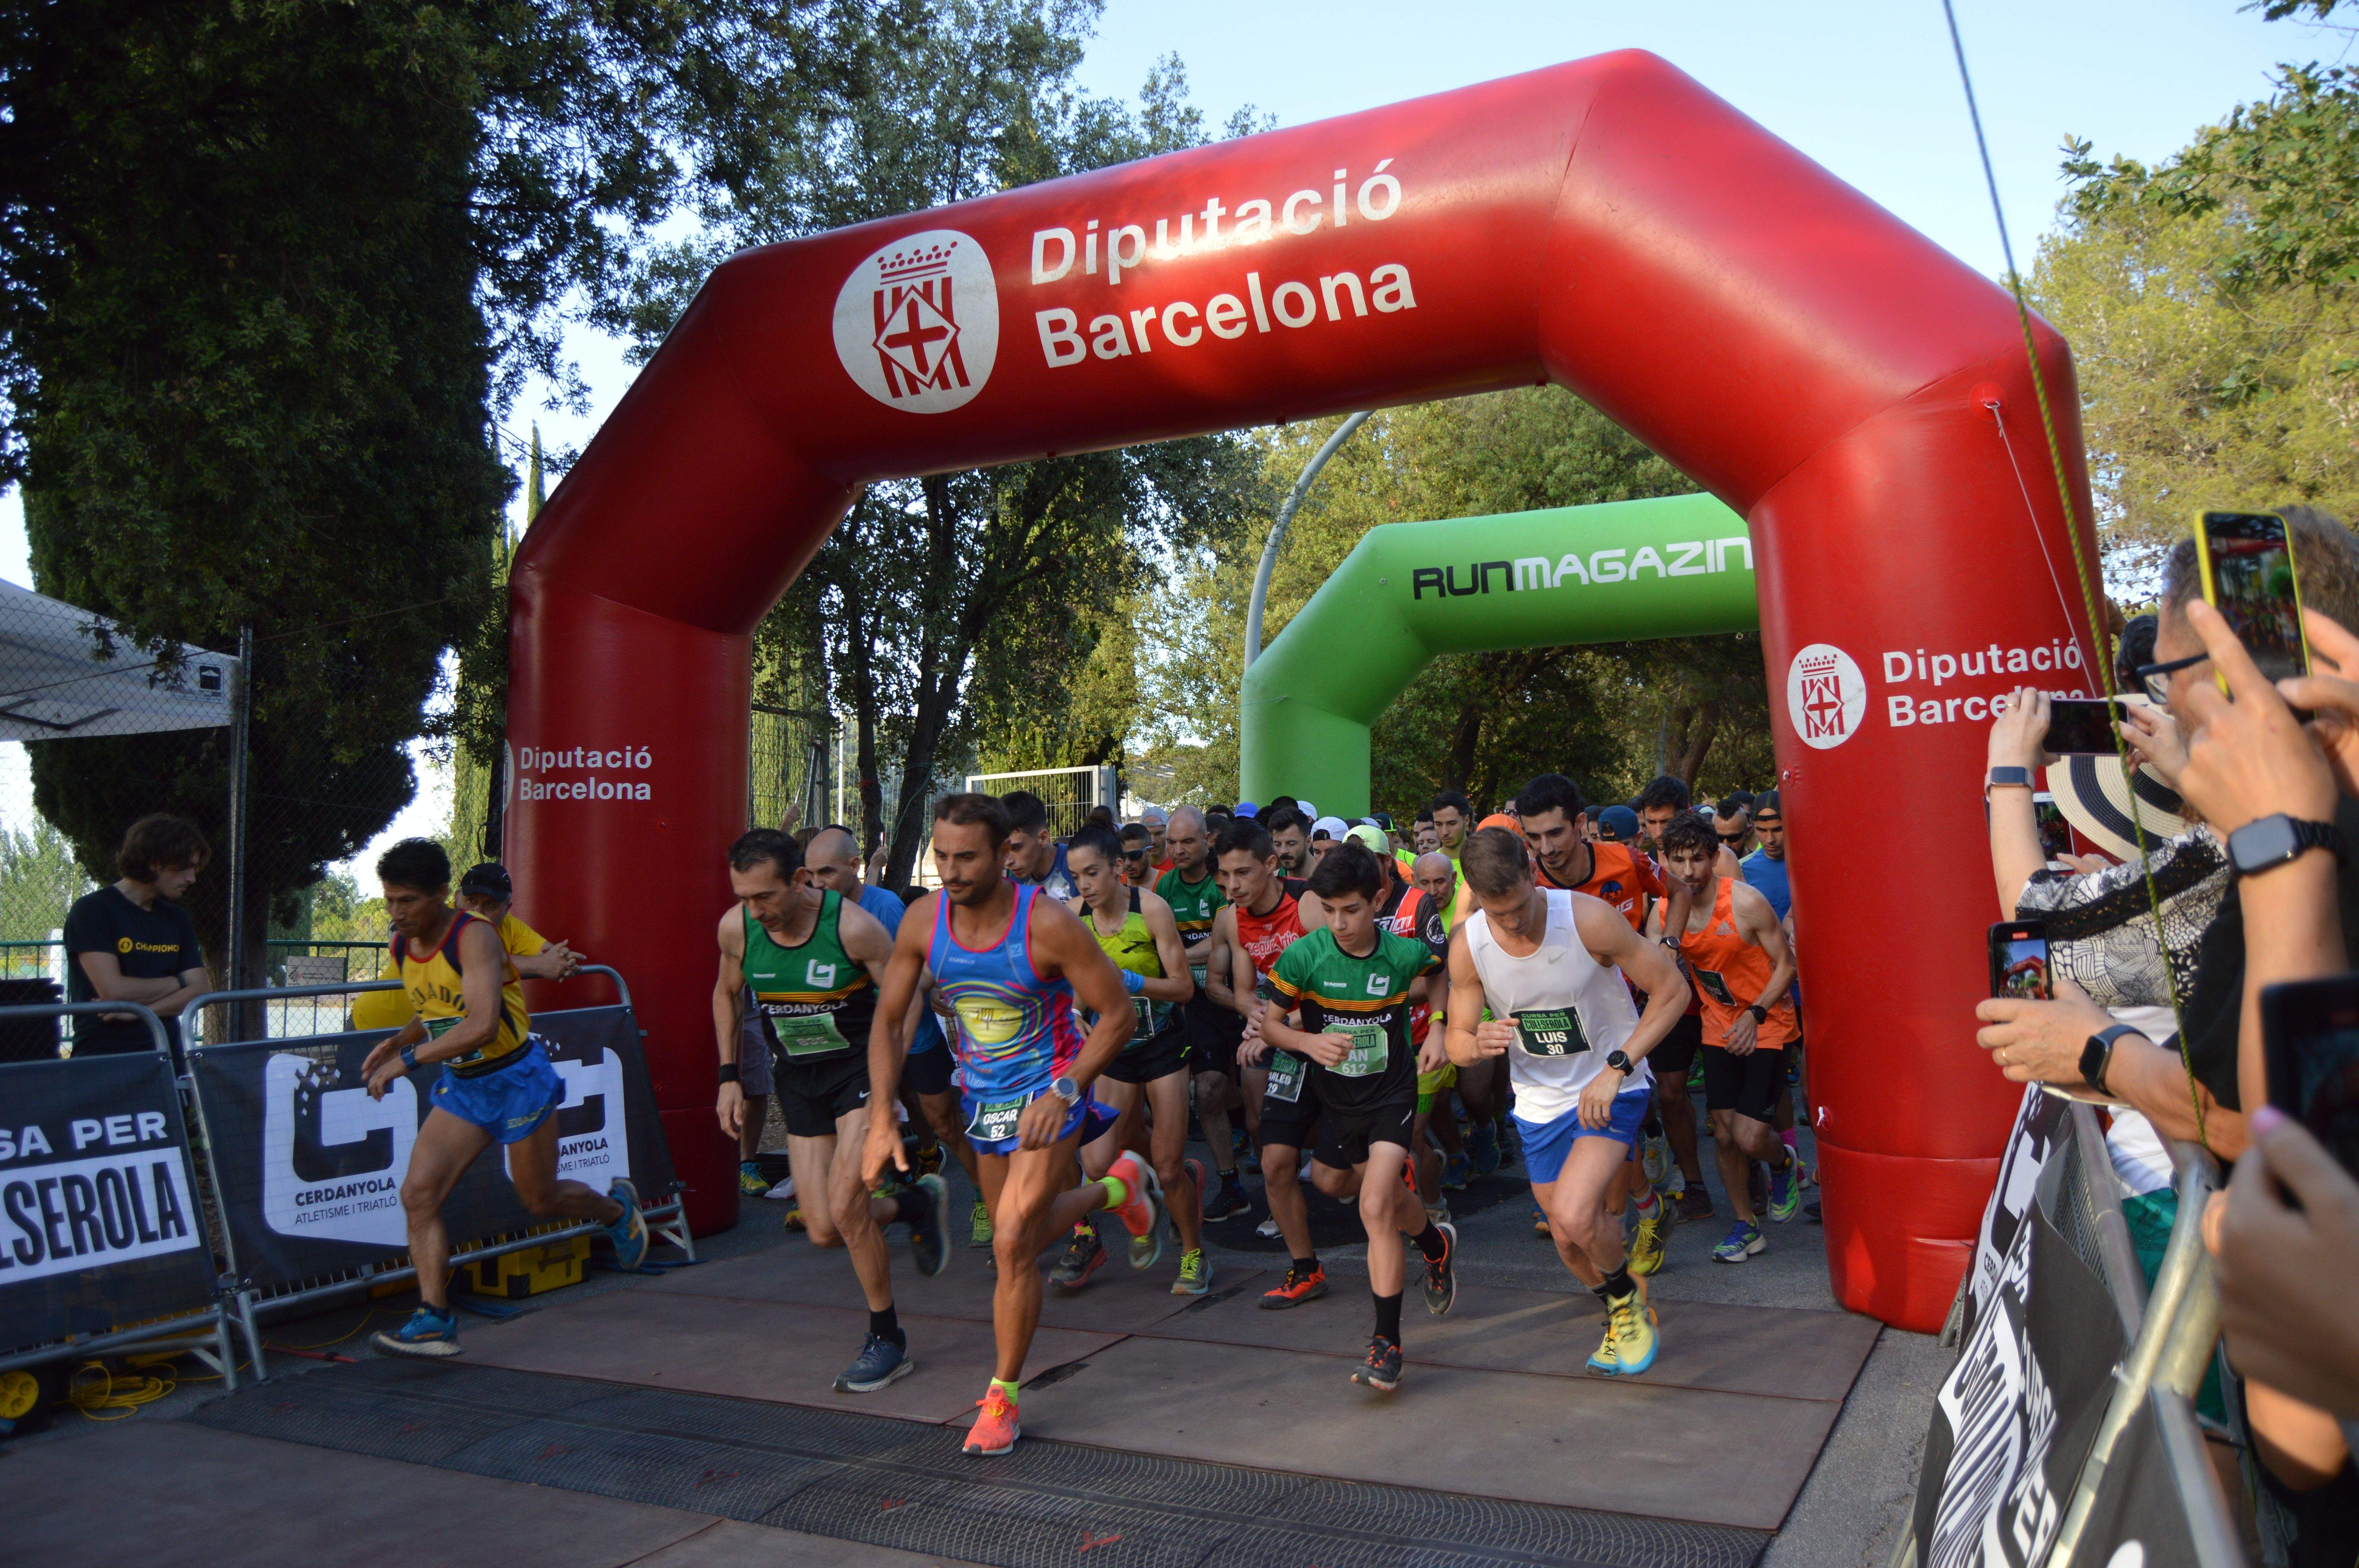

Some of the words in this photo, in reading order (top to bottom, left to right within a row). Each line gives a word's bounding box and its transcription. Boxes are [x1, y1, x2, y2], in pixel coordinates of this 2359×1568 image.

[1031, 158, 1402, 285] Diputació
[1036, 263, 1417, 368] Barcelona
[1883, 638, 2081, 686] Diputació
[1887, 686, 2085, 727] Barce
[521, 746, 652, 773] Diputació
[520, 777, 651, 800] Barcelona
[1524, 1018, 1570, 1029] COLLSEROLA
[1352, 1035, 1376, 1048] EROLA
[1534, 1031, 1568, 1043] LUIS
[1348, 1049, 1369, 1062] AN
[1546, 1044, 1565, 1055] 30
[1342, 1063, 1367, 1075] 612
[983, 1109, 1018, 1125] OSCAR
[72, 1112, 168, 1149] PER
[990, 1124, 1006, 1138] 52
[559, 1138, 609, 1157] ANYOLA
[578, 1152, 610, 1168] TRIATLÓ
[295, 1177, 396, 1207] CERDANYOLA
[295, 1205, 350, 1225] ATLETISME
[353, 1204, 355, 1213] I
[357, 1193, 397, 1213] TRIATLÓ
